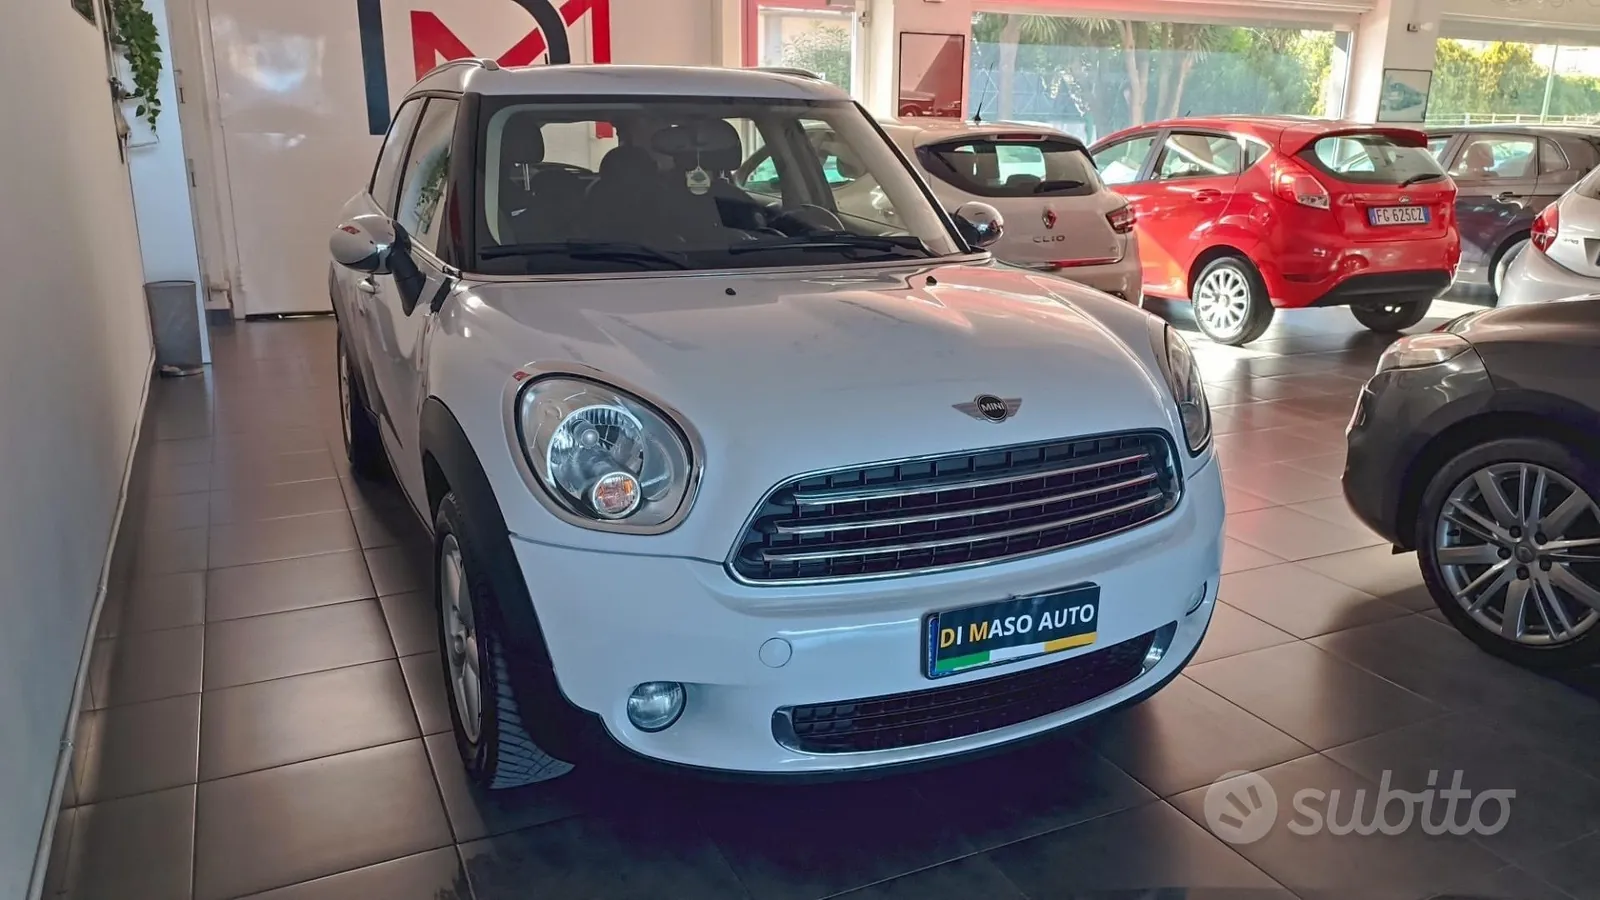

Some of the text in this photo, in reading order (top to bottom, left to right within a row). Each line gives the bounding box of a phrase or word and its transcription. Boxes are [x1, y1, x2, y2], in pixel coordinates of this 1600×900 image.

[1376, 208, 1424, 223] FG 625CZ
[980, 402, 1005, 412] MINI
[940, 603, 1095, 648] DI MASO AUTO
